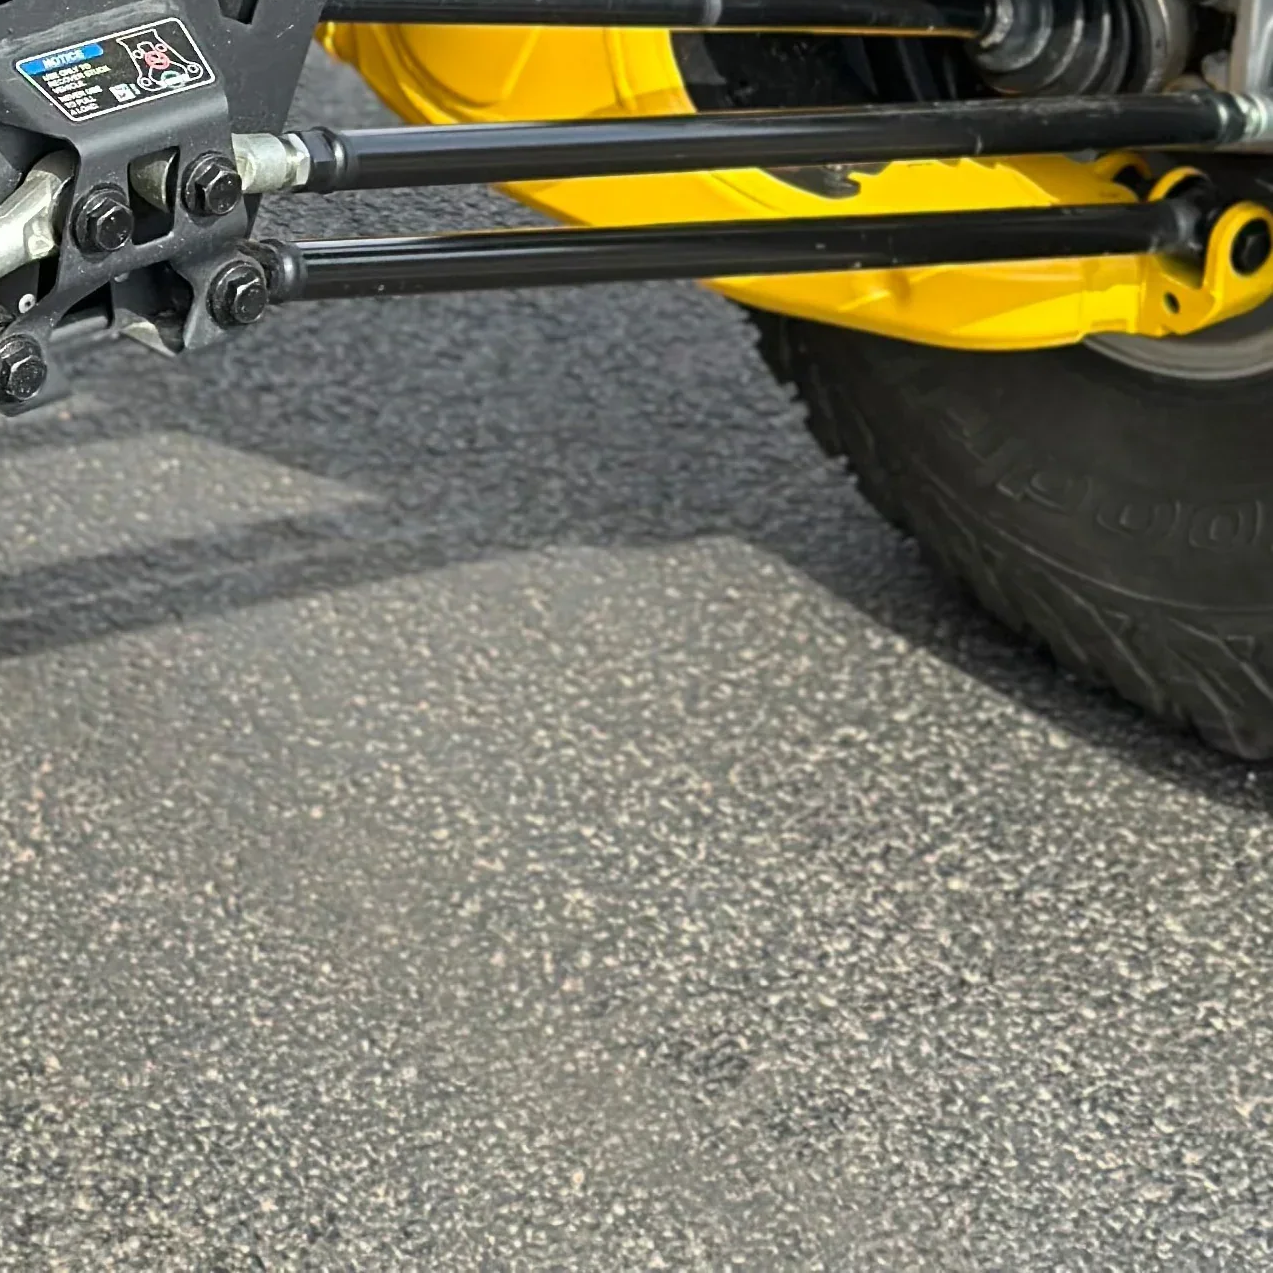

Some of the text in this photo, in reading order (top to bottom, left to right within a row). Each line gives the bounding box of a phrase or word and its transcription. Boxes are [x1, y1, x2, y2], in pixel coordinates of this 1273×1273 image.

[42, 49, 85, 70] NOTICE
[59, 66, 79, 76] ONLY
[79, 63, 92, 71] TO
[47, 72, 85, 88] RECOVER
[64, 101, 77, 109] TO
